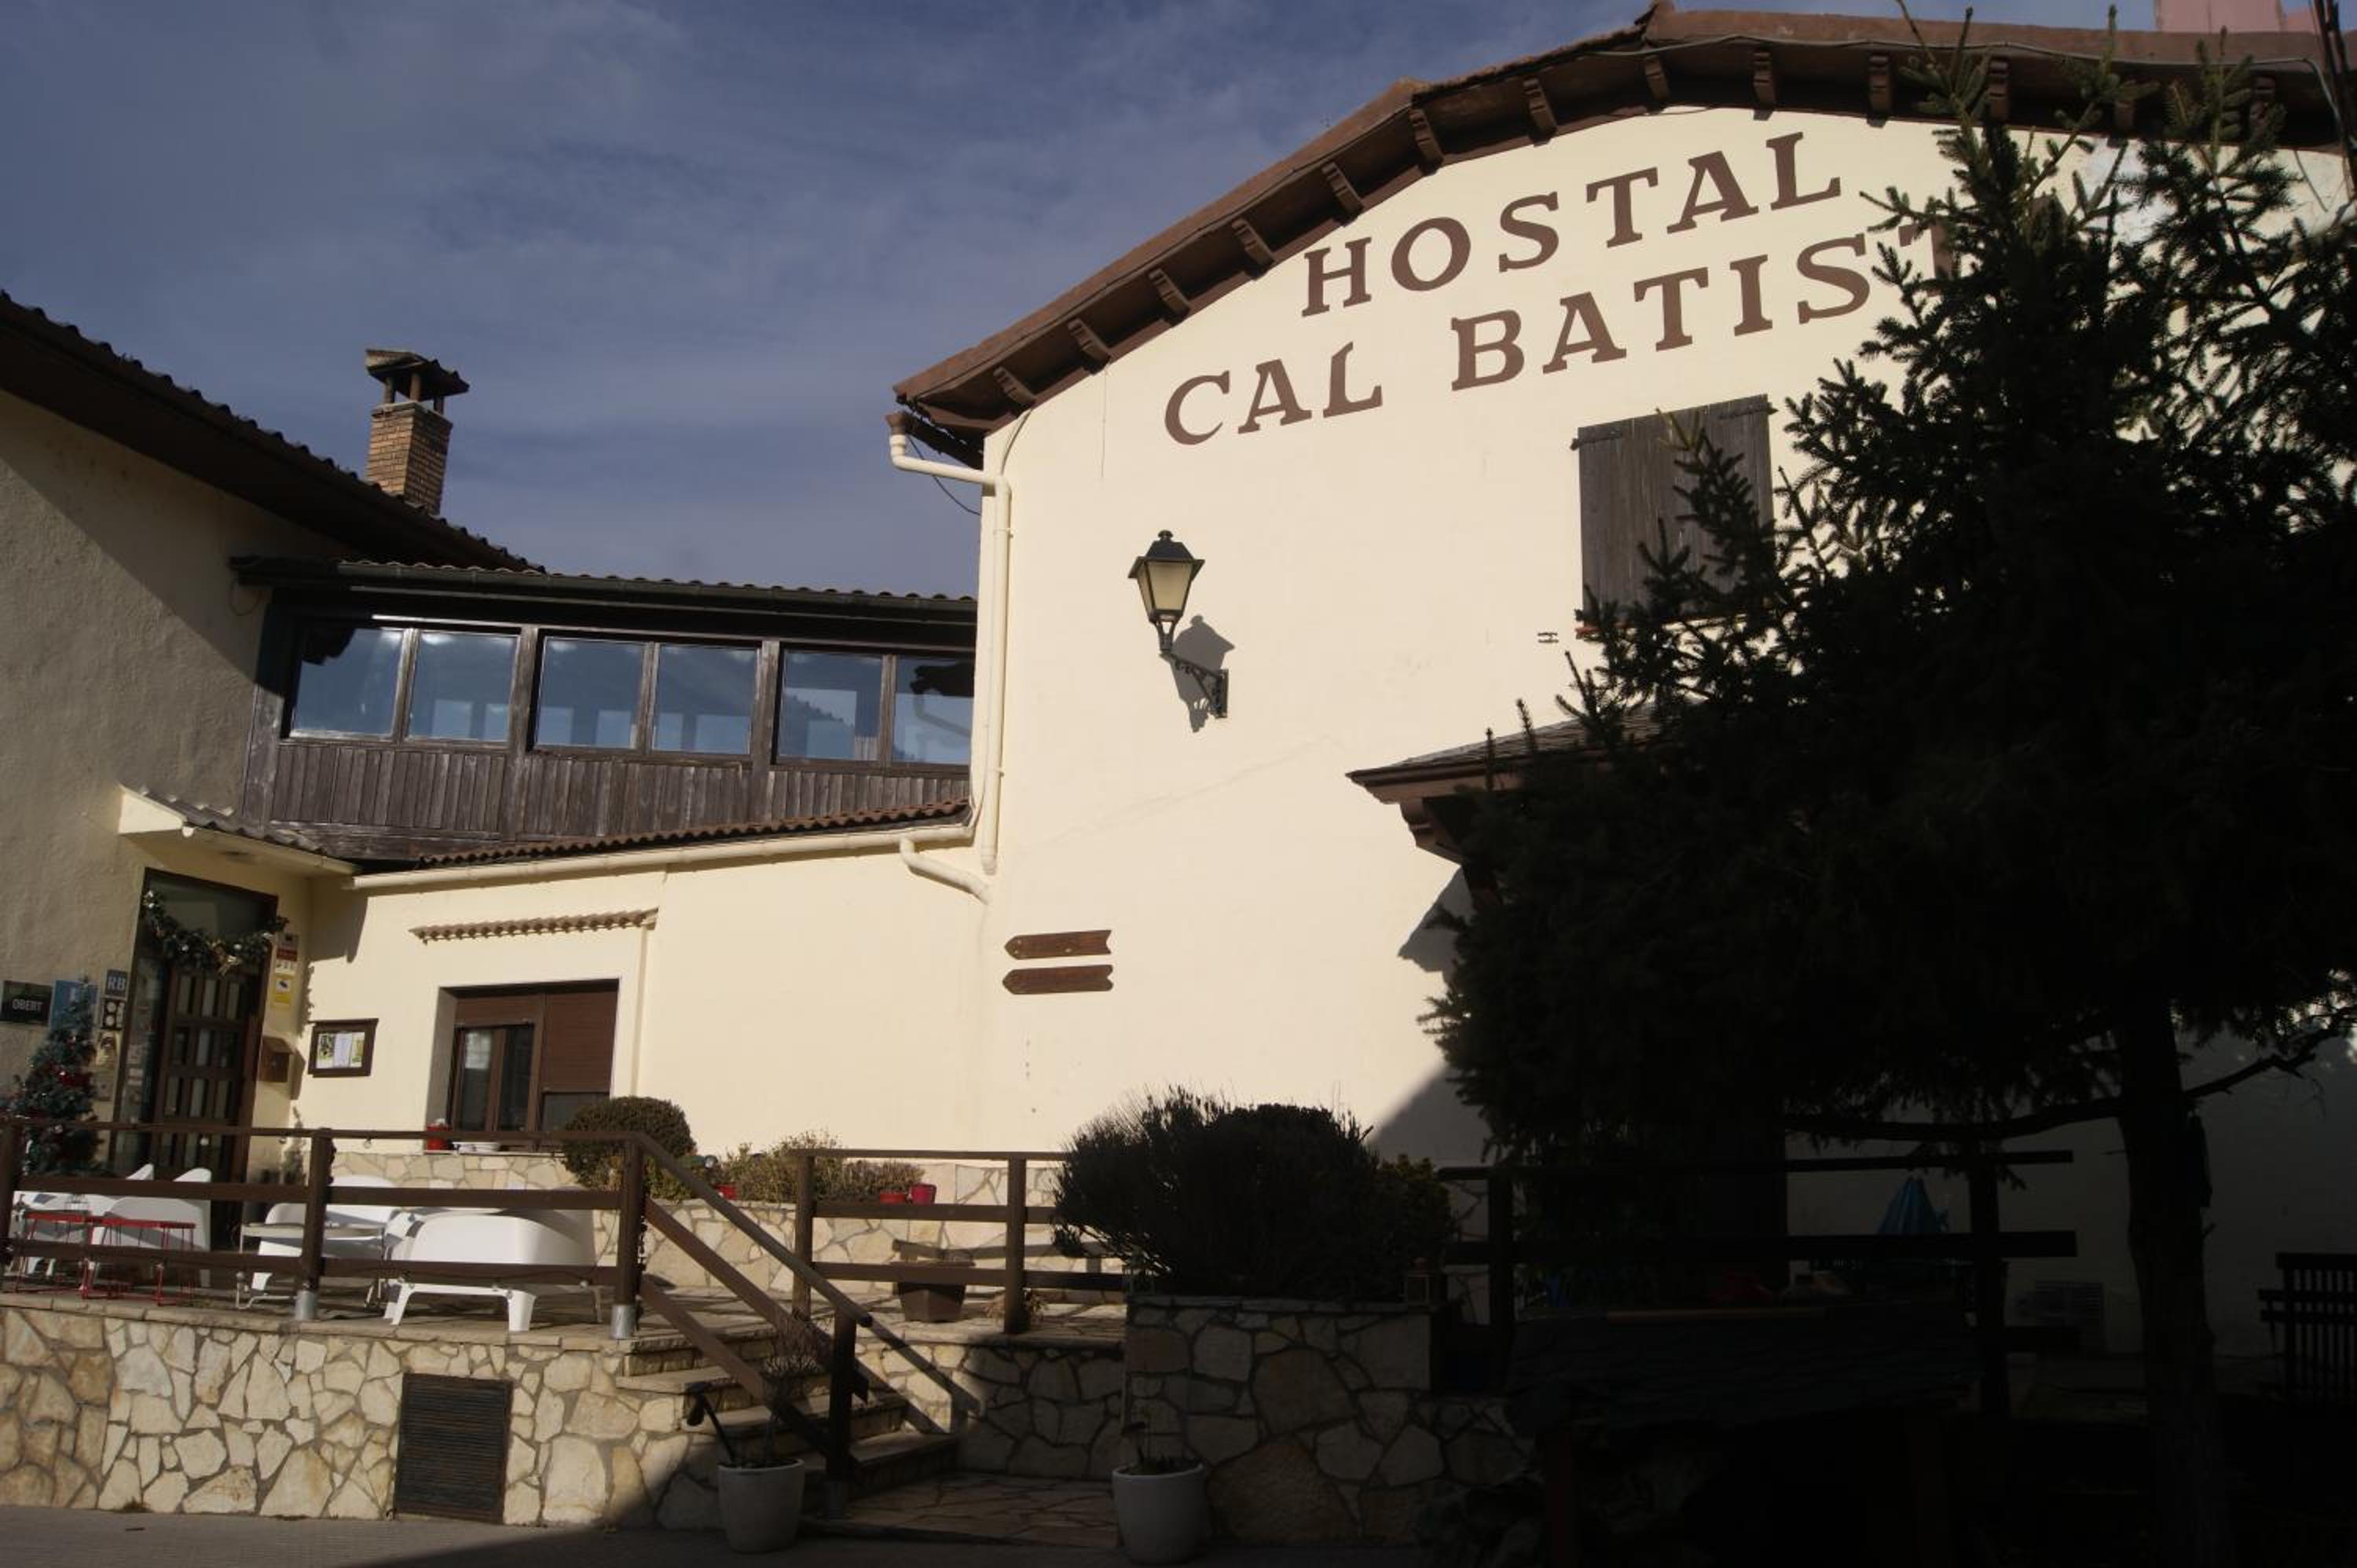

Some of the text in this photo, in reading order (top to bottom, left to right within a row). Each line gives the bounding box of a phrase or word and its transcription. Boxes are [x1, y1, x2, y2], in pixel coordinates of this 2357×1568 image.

[1302, 132, 1841, 317] HOSTAL
[1165, 343, 1382, 445] CAL
[12, 998, 43, 1011] OBERT
